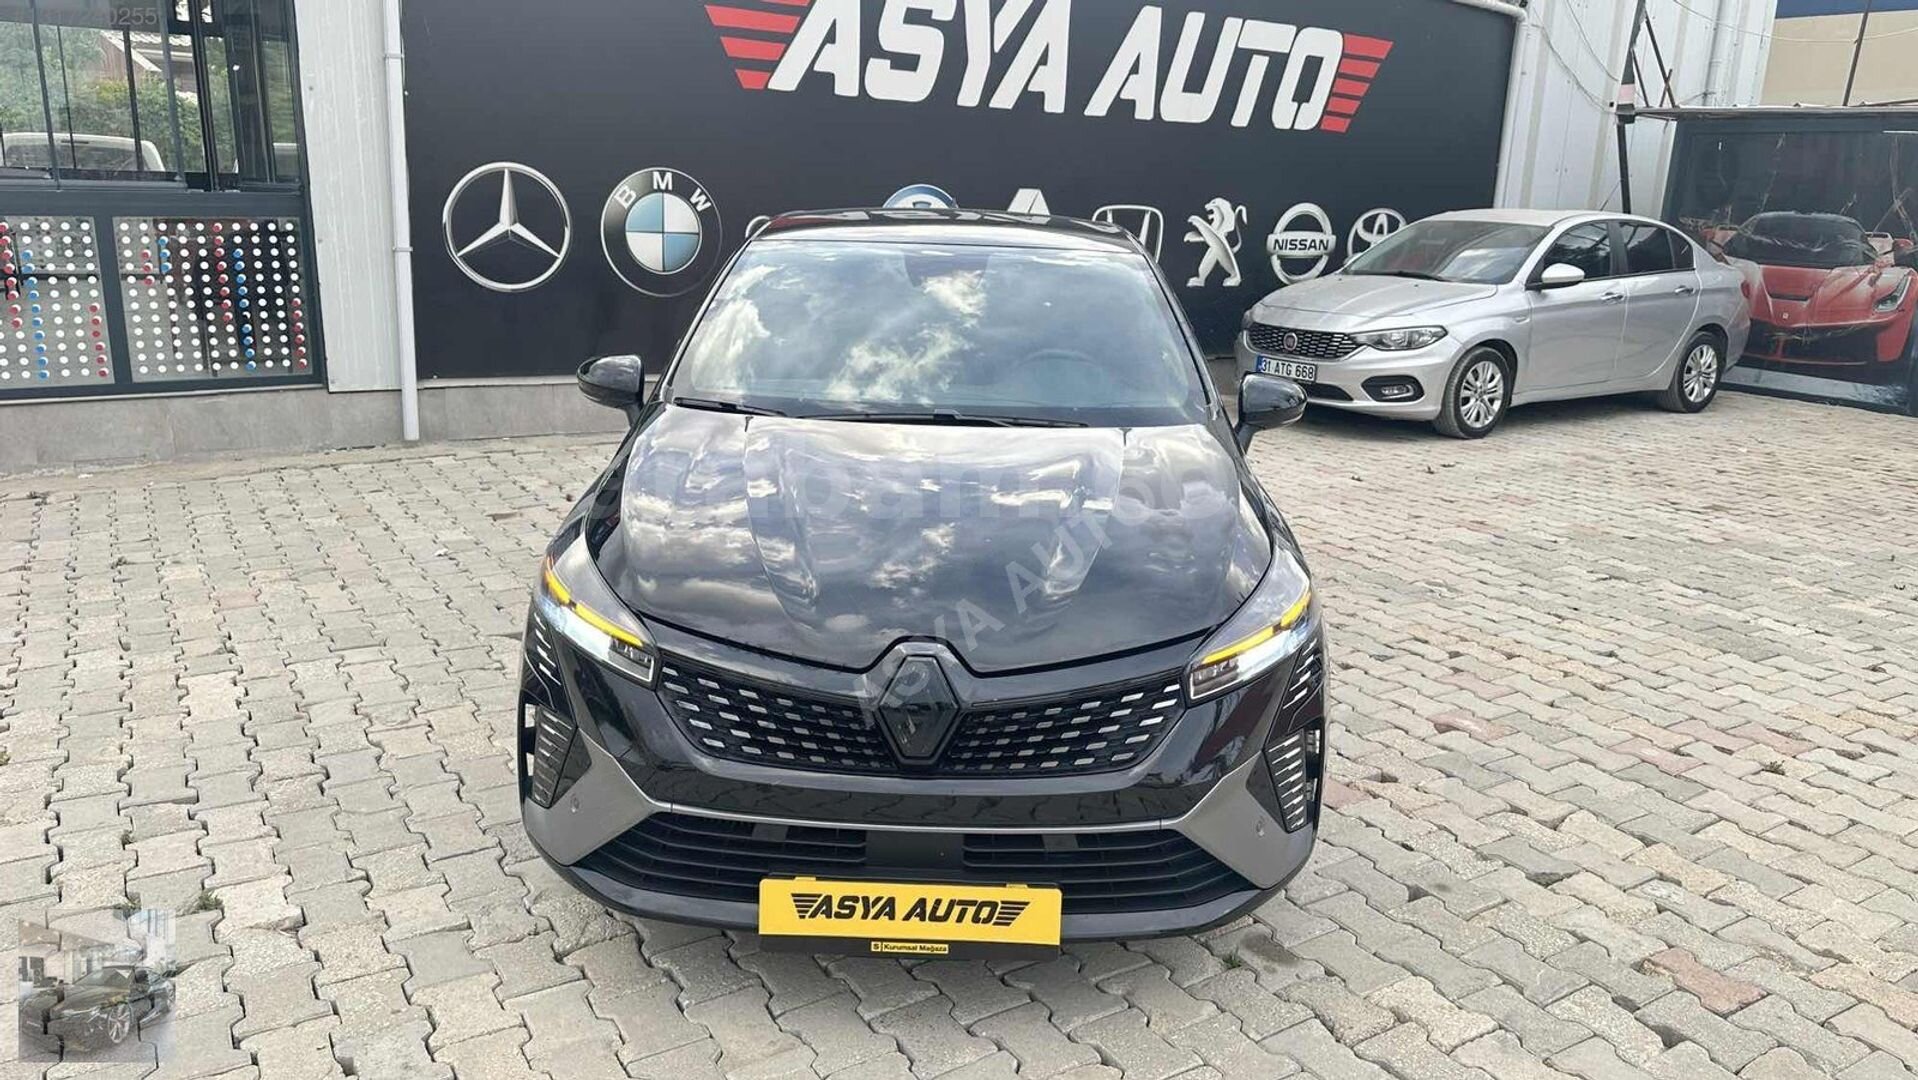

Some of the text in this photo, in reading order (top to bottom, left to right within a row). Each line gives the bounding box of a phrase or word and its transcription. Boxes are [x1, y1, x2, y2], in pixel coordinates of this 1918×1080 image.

[767, 0, 1344, 131] ASYA AUTO
[613, 171, 712, 211] BMW
[1273, 238, 1330, 251] NISSAN
[1261, 360, 1314, 380] 31 ATG 668
[808, 894, 1001, 924] ASYA AUTO
